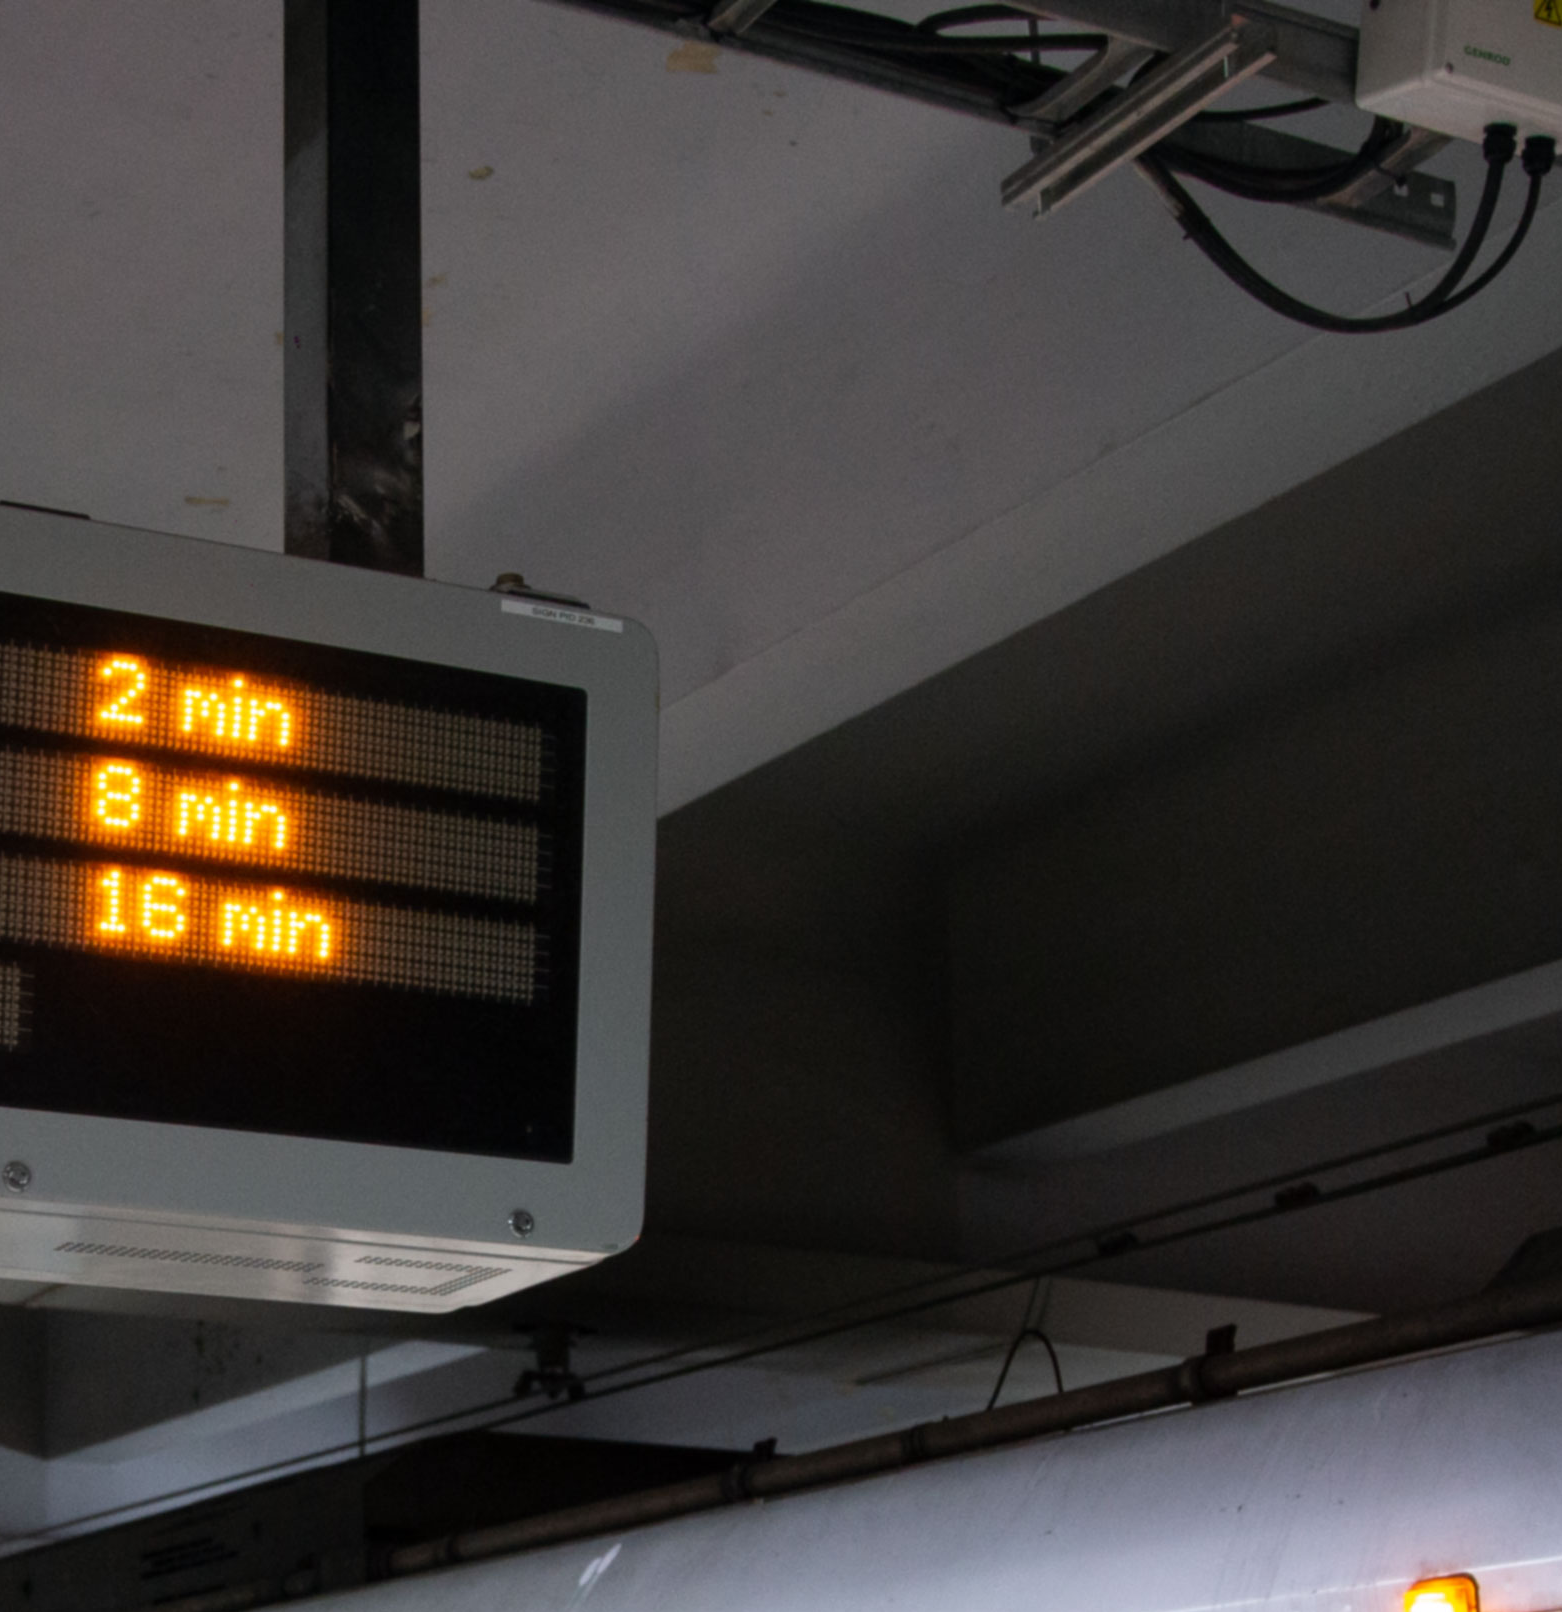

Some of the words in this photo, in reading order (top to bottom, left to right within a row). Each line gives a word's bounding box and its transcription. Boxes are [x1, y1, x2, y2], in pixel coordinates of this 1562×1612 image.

[97, 657, 147, 727] 2
[182, 676, 293, 748] min
[94, 763, 143, 829] 8
[176, 779, 287, 851] min
[98, 868, 187, 940] 16
[221, 889, 332, 960] min
